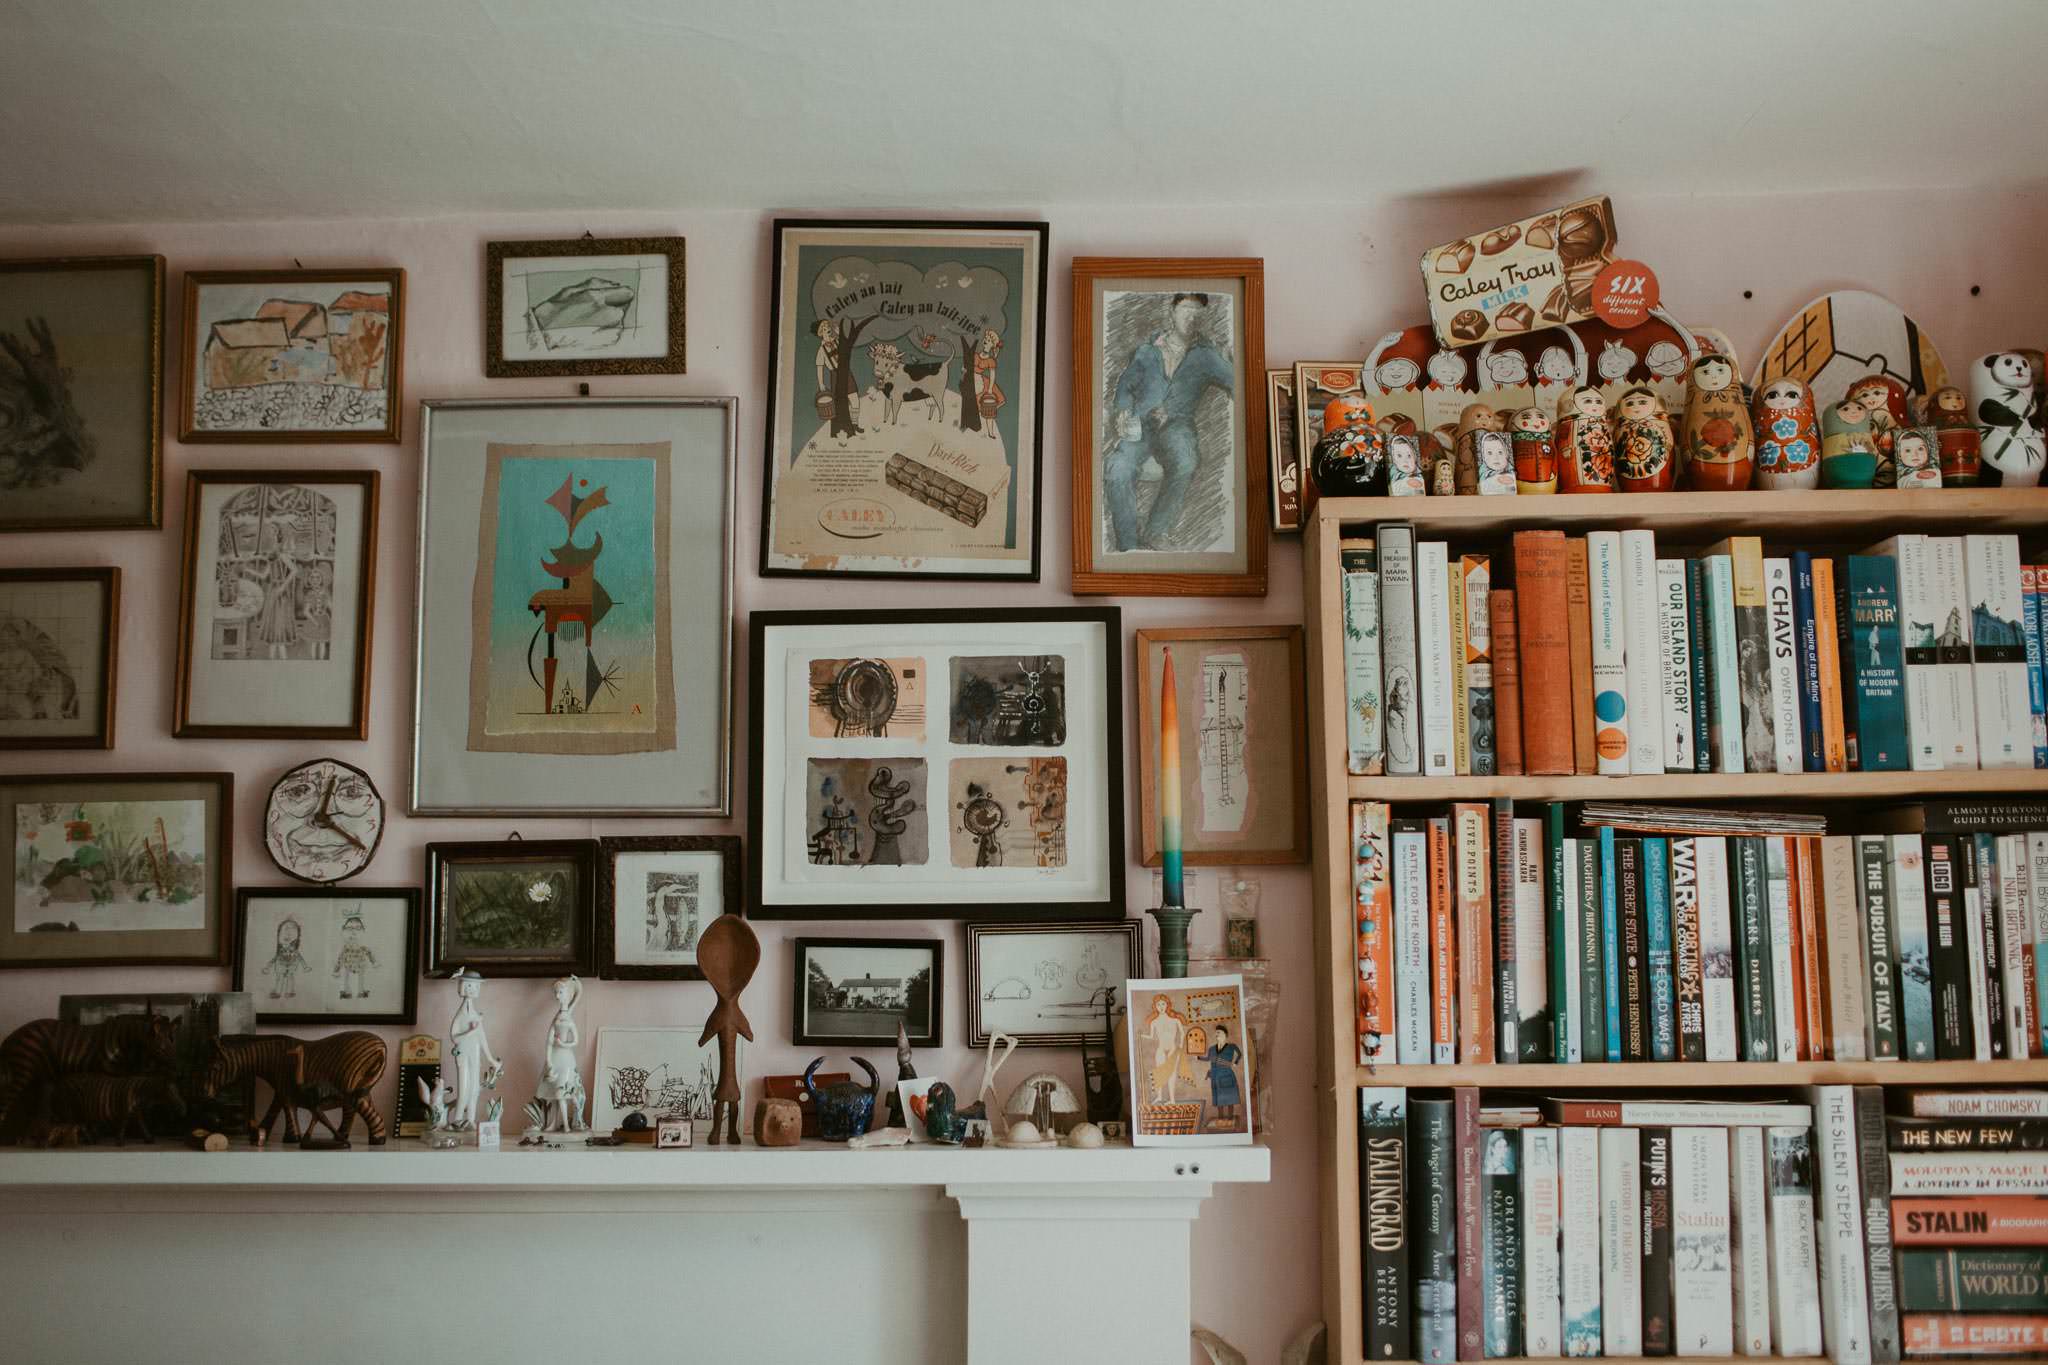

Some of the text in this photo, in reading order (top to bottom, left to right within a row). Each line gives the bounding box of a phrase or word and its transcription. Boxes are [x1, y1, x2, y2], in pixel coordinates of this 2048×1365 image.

[1439, 260, 1557, 303] Caley Tray
[1608, 276, 1646, 295] SIX
[825, 291, 858, 318] Caley
[880, 281, 903, 296] lait
[880, 300, 914, 316] Caley
[1602, 296, 1644, 308] different
[1600, 542, 1613, 650] The World of Espionage
[1661, 611, 1671, 646] HISTORY
[1856, 608, 1895, 622] MARR
[1663, 650, 1671, 658] OF
[1669, 583, 1688, 715] OUR ISLAND STORY
[2025, 610, 2040, 668] YORI AOSHI
[1771, 586, 1795, 746] CHAVS OWEN JONES
[1806, 619, 1820, 702] Empire of the Mind
[1860, 669, 1896, 677] A HISTORY
[1662, 661, 1673, 696] BRITAIN
[1858, 679, 1868, 687] OF
[1947, 807, 1988, 815] ALMOST
[1953, 816, 2003, 824] GUIDE TO
[1466, 818, 1476, 846] FIVE
[1518, 828, 1529, 883] CHANDRASEKARAN
[1650, 843, 1662, 869] JOHN
[1931, 845, 1949, 861] NO
[1979, 847, 1991, 867] WHY
[2034, 855, 2048, 882] Bill
[1466, 850, 1478, 895] POINTS
[1497, 811, 1514, 961] THROUGH HELL FOR HITLER
[1528, 863, 1538, 883] RAJIV
[1554, 846, 1564, 911] The Rights of Man
[1583, 845, 1595, 901] DAUGHTERS
[1652, 872, 1663, 903] LEWIS
[1867, 860, 1882, 891] THE
[1932, 863, 1950, 890] LOGO
[1981, 868, 1991, 880] DO
[1409, 844, 1421, 967] BATTLE FOR THE NORTH
[1981, 880, 1992, 907] PEOPLE
[1435, 825, 1445, 867] MARGARET
[1440, 1009, 1449, 1041] HISTORY
[1672, 838, 1702, 1032] WAR REPORTING CHRIS
[1743, 846, 1762, 1016] ALAN CLARK DIARIES
[1869, 894, 1887, 958] PURSUIT
[1983, 908, 1994, 927] HATE
[2003, 875, 2022, 971] INDIA BRITANNICA
[1585, 912, 1598, 963] BRITANNIA
[1622, 846, 1641, 1057] THE SECRET STATE PETER HENNESSY
[1938, 925, 1953, 947] KLEIN
[1984, 928, 1996, 968] AMERICA?
[1656, 956, 1667, 979] THE
[1678, 928, 1692, 1033] COWARDS AYRES
[1873, 961, 1889, 986] OF
[1657, 981, 1669, 1012] COLD
[1841, 992, 1854, 1024] Belief
[1875, 990, 1892, 1034] ITALY
[1659, 1014, 1670, 1041] WAR
[1558, 1039, 1567, 1058] Paine
[1829, 1095, 1845, 1122] THE
[1947, 1099, 2042, 1114] NOAM CHOMSKY
[1430, 1118, 1443, 1140] The
[1901, 1128, 2014, 1146] THE NEW FEW
[1428, 1143, 1443, 1178] Angel
[1463, 1146, 1474, 1173] Russia
[1832, 1128, 1850, 1179] SILENT
[1430, 1178, 1443, 1190] of
[1463, 1175, 1476, 1213] Through
[1642, 1137, 1667, 1229] PUTIN'S RUSSIA
[1428, 1192, 1443, 1235] Grozny
[1534, 1178, 1553, 1237] GULAG
[1677, 1211, 1728, 1228] Stalin
[1835, 1183, 1854, 1240] STEPPE
[1905, 1211, 1988, 1234] STALIN
[1367, 1137, 1403, 1328] STALINGRAD ANTONY
[1464, 1214, 1475, 1256] Women's
[1493, 1189, 1505, 1270] NATASHA'S
[1643, 1206, 1653, 1256] POLITKOVSKAYA
[1867, 1208, 1890, 1244] GOOD
[1463, 1256, 1476, 1277] Eyes
[1504, 1194, 1517, 1317] ORLANDO FIGES
[1799, 1234, 1810, 1269] EARTH
[1960, 1258, 2042, 1275] Dictionary of
[1376, 1268, 1388, 1325] BEEVOR
[1870, 1247, 1895, 1313] SOLDIERS
[1961, 1274, 2039, 1296] WORLD
